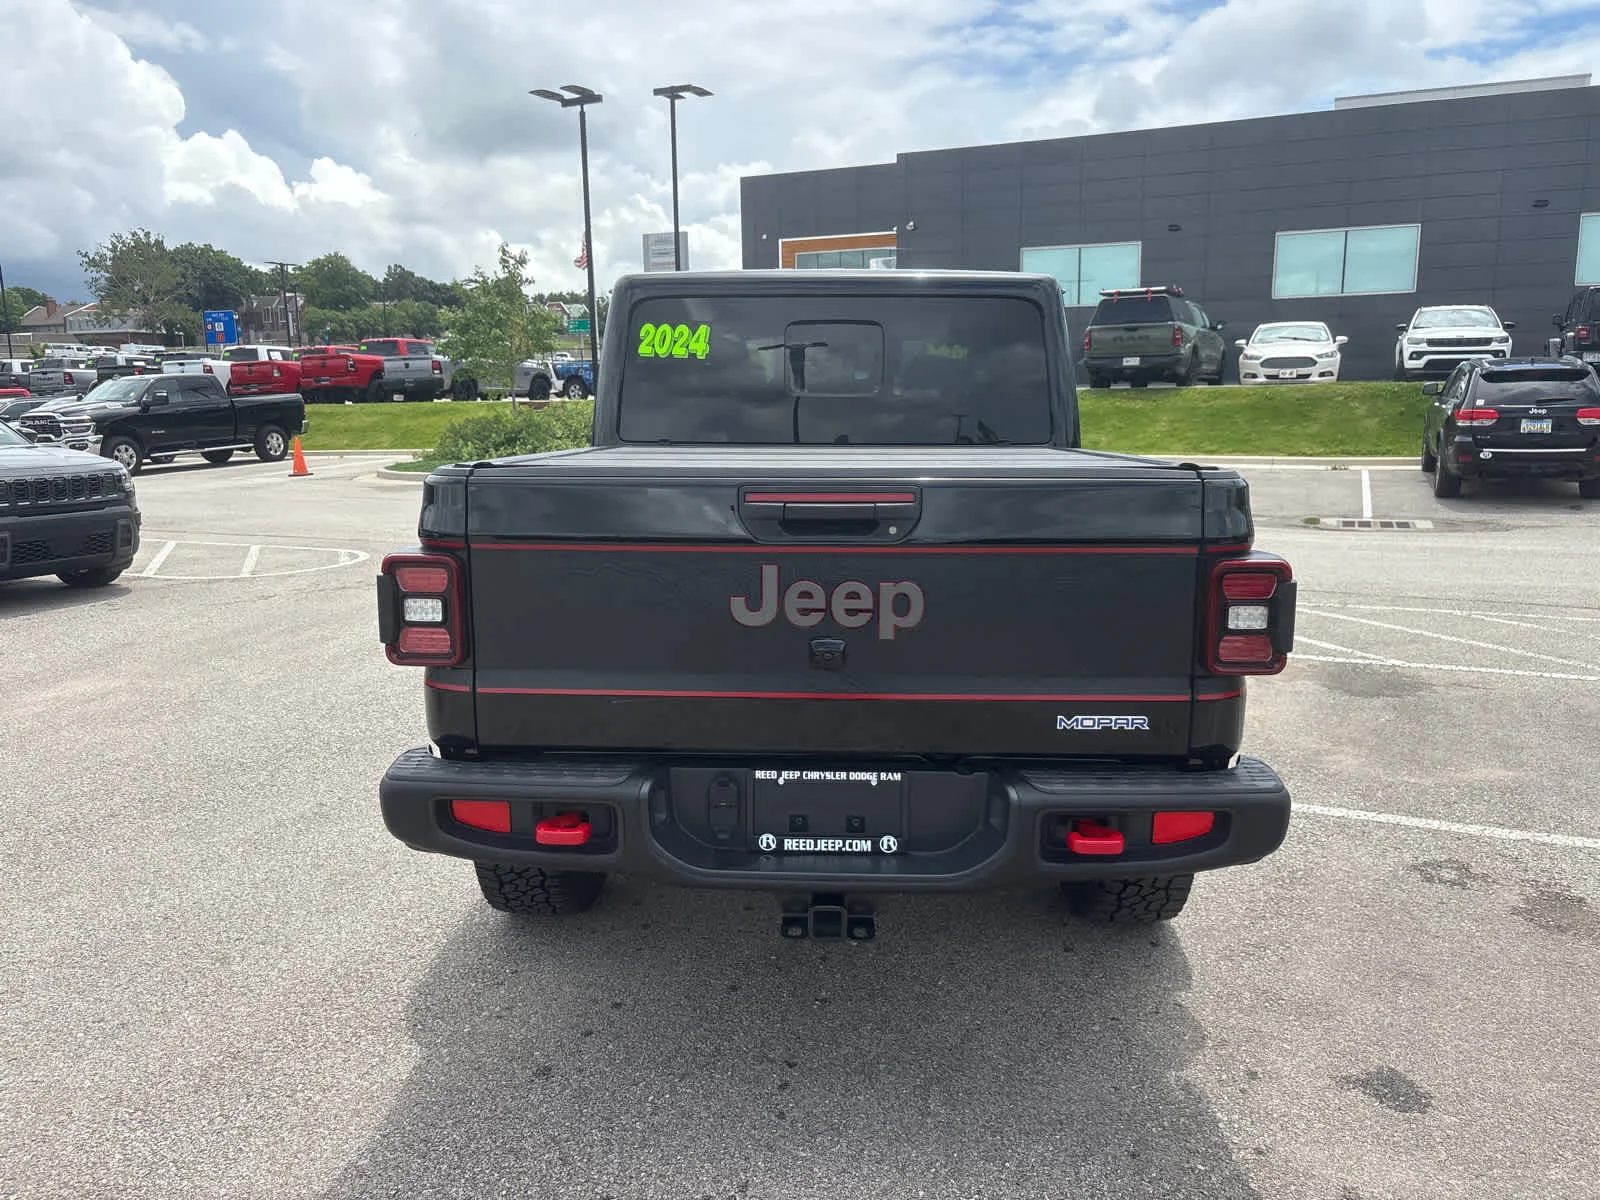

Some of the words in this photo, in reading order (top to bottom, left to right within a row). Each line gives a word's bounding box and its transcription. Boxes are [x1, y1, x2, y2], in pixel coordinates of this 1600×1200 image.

[638, 323, 710, 359] 2024
[730, 564, 924, 640] Jeep
[1057, 716, 1150, 729] MOPAR
[755, 770, 777, 779] REED
[780, 771, 801, 780] JEEP
[802, 771, 847, 780] CHRYSLER
[849, 772, 878, 781] DODGE
[880, 772, 901, 781] RAM
[783, 838, 872, 852] REEDJEEP.COM
